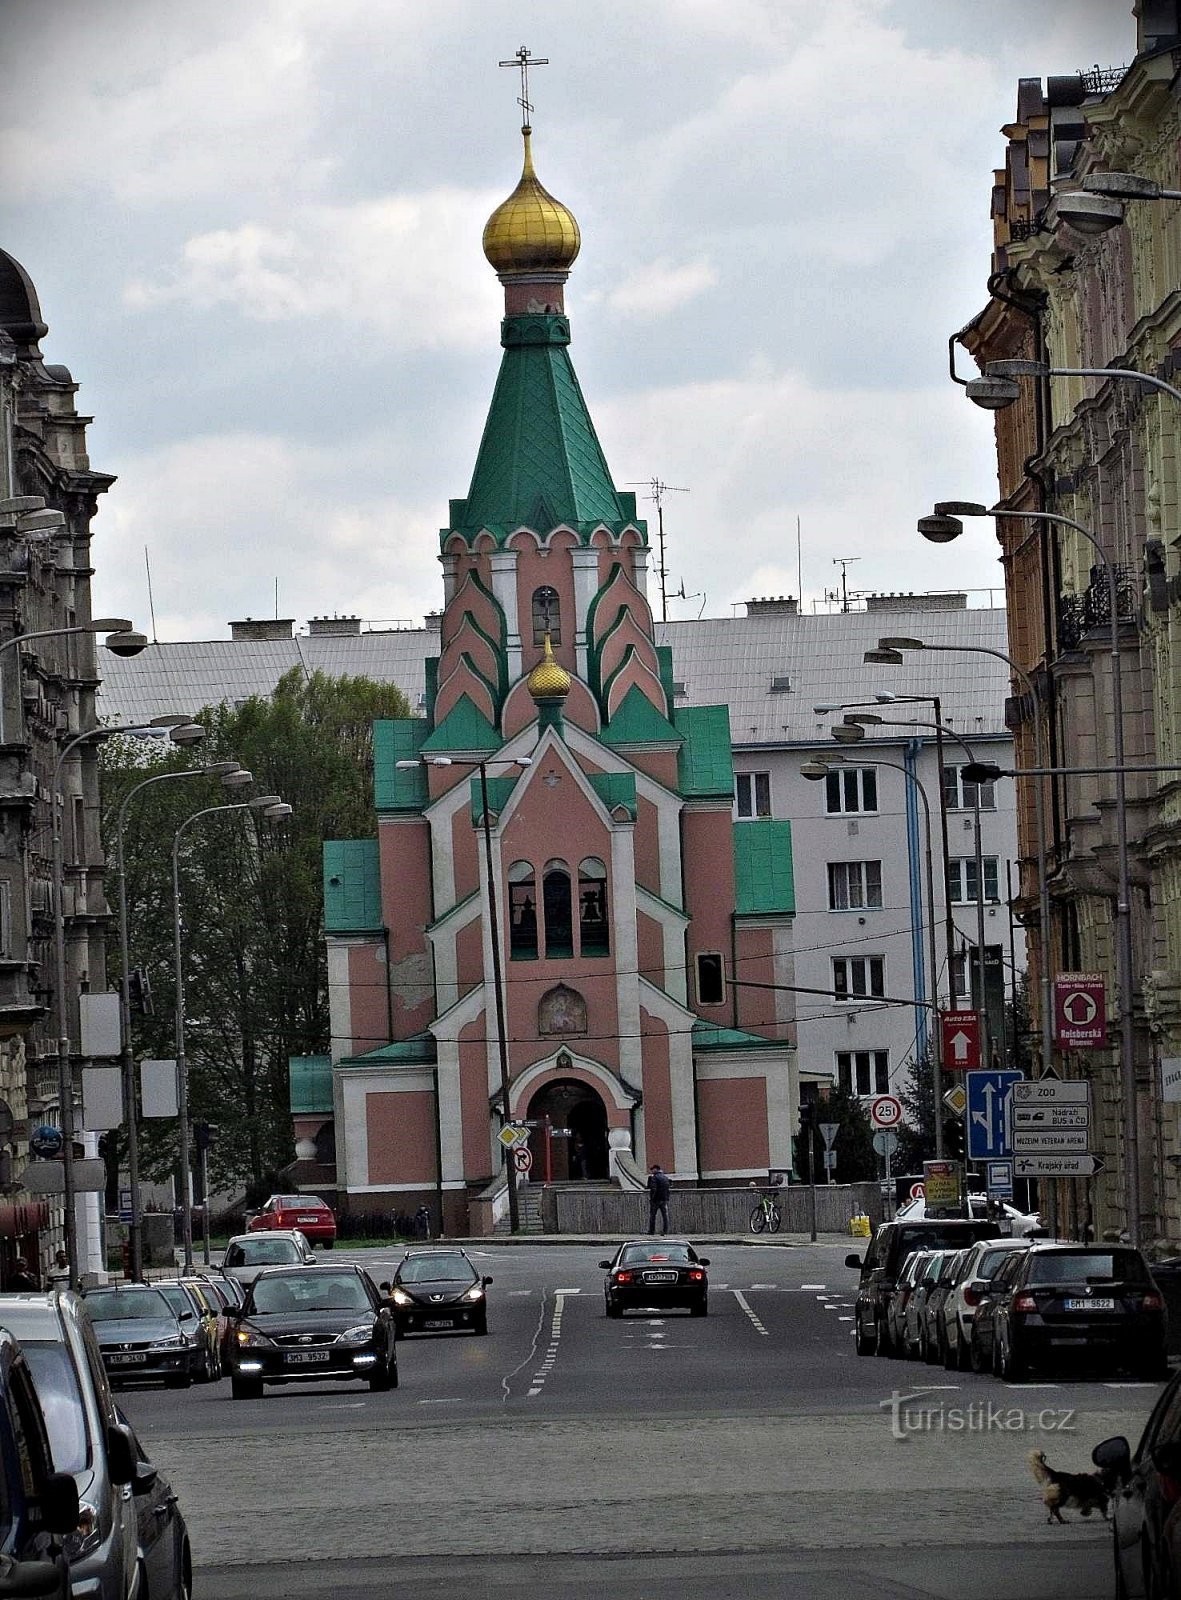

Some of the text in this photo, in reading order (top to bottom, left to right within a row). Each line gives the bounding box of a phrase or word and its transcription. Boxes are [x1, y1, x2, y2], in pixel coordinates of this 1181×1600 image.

[1056, 973, 1103, 982] HORNBACH
[1038, 1088, 1056, 1097] ZOO
[1053, 1108, 1079, 1117] Nádraží
[1053, 1117, 1068, 1125] BUS
[1016, 1137, 1084, 1145] MUZEUM VETERAN ARENA
[1038, 1159, 1080, 1172] Krajský úřad
